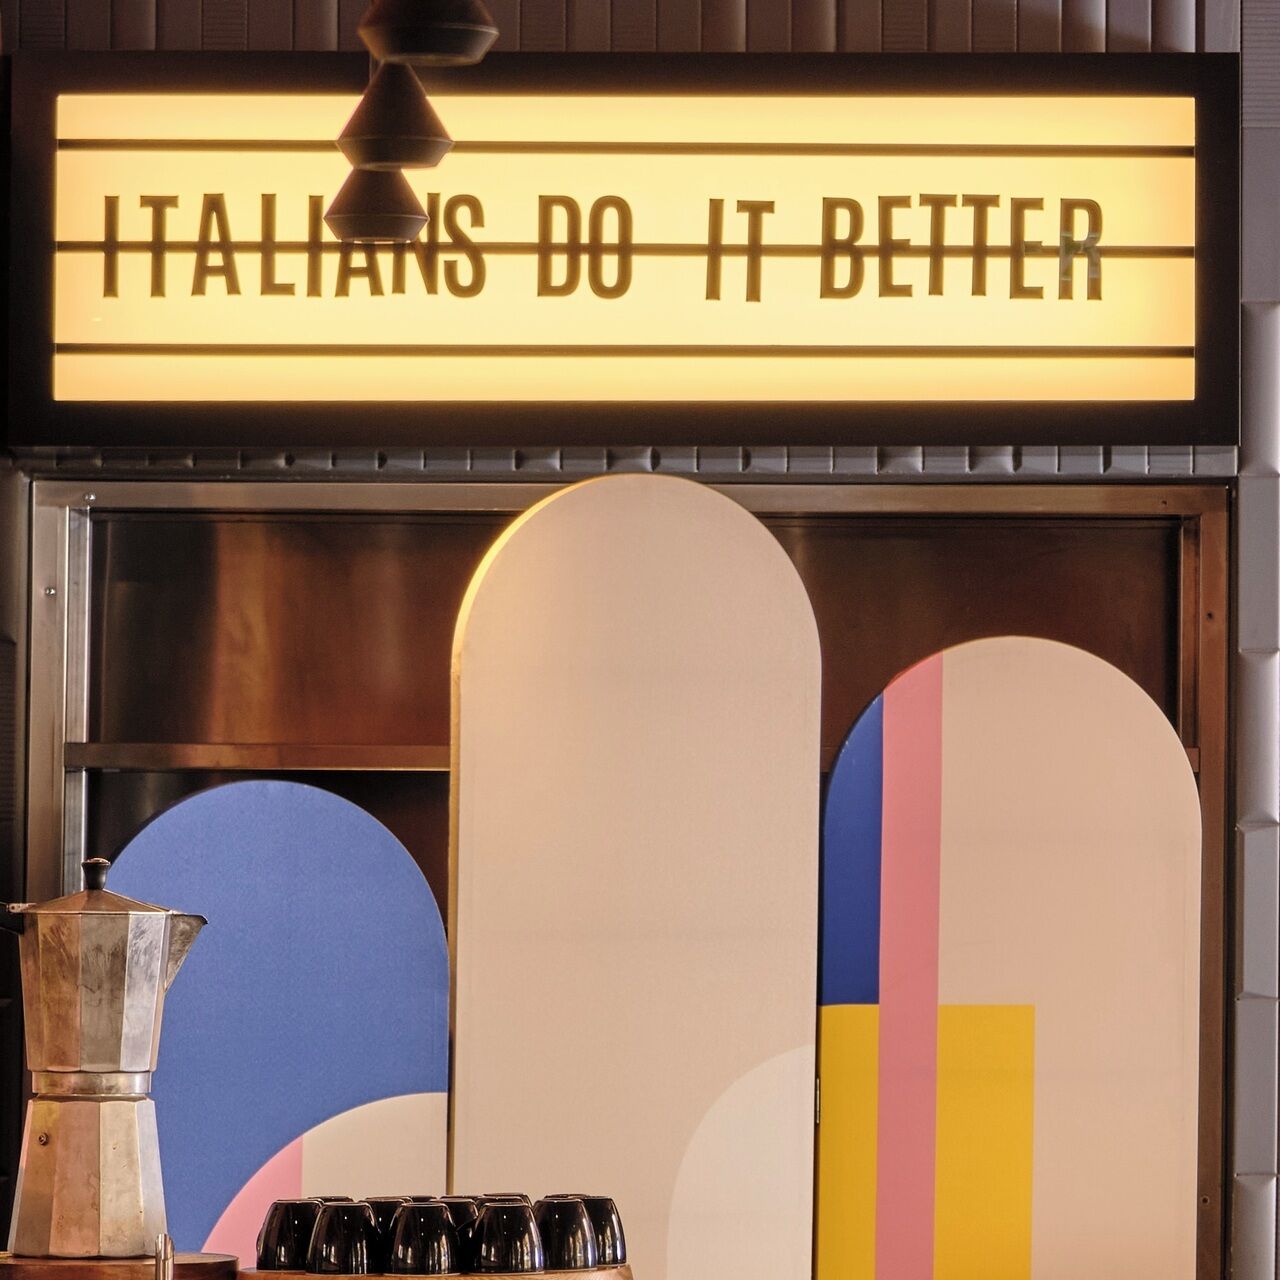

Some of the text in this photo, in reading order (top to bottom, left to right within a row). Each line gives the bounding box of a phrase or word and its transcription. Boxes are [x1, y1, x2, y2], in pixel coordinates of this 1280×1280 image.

[103, 192, 1104, 303] ITALIANS DO IT BETTER
